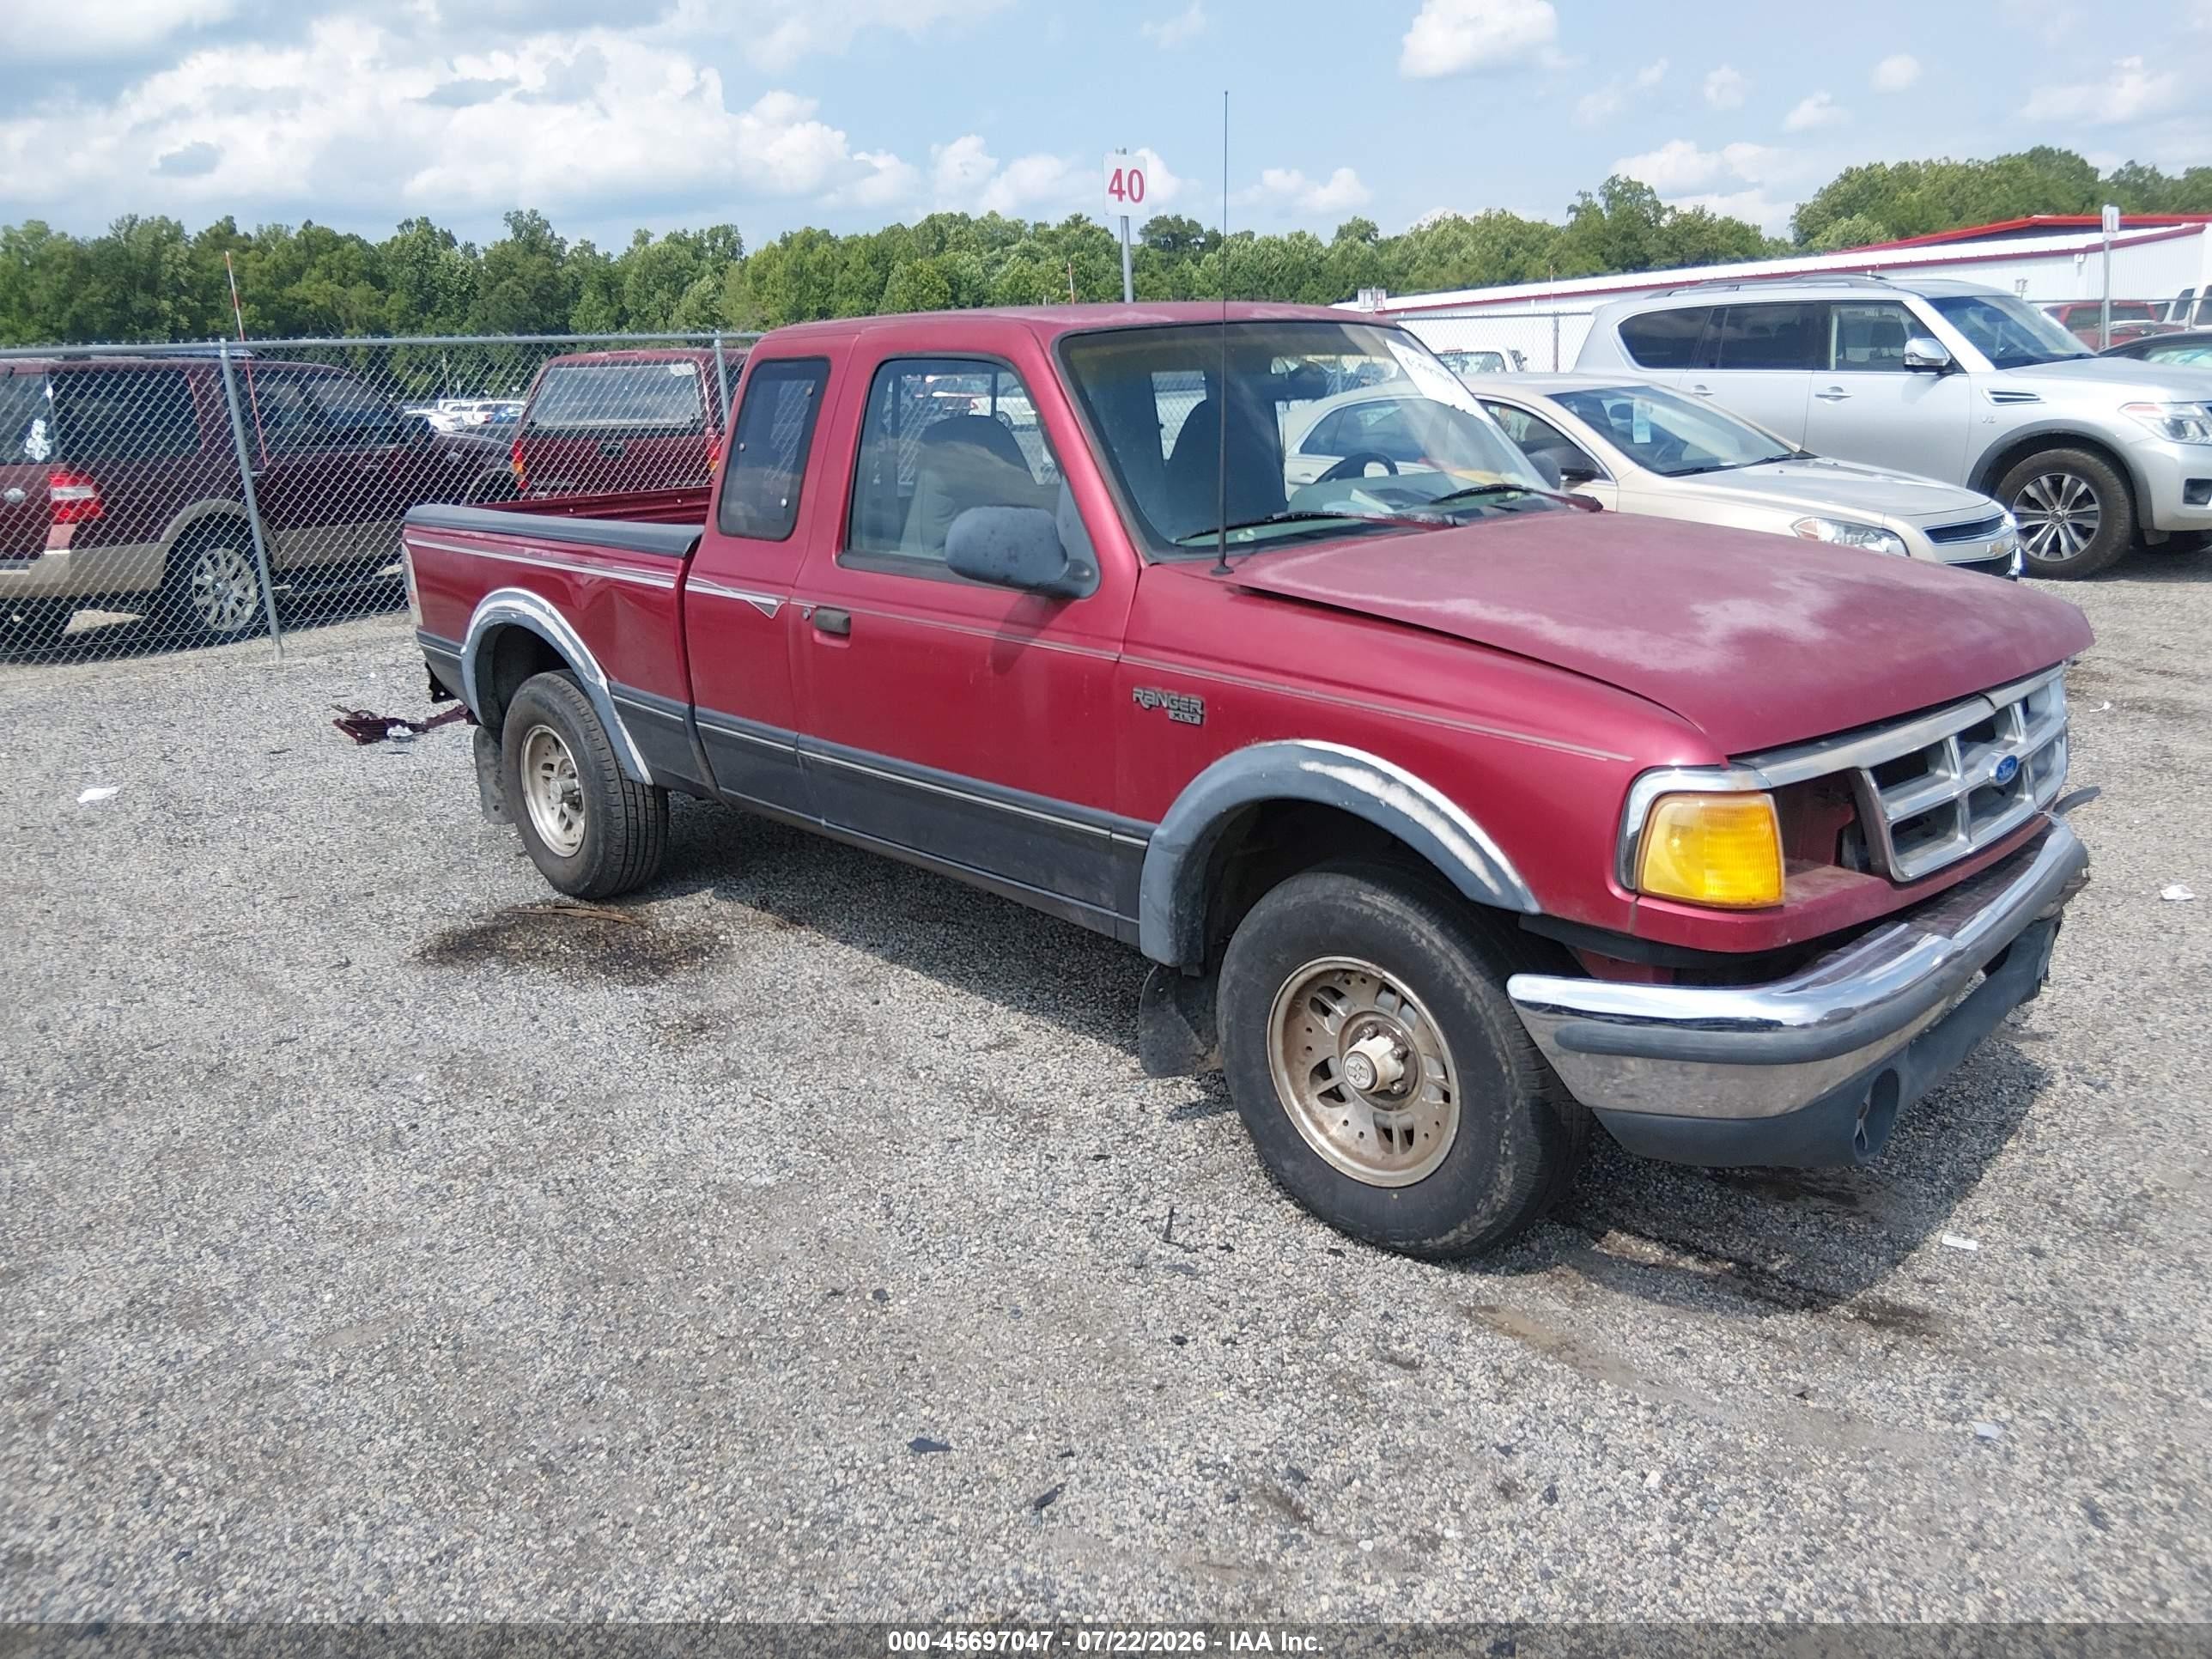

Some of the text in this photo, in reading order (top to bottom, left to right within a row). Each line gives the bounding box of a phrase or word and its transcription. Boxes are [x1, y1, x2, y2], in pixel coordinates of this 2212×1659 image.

[1108, 168, 1145, 204] 40
[1133, 687, 1204, 715] RANGER
[1172, 712, 1196, 723] XLT
